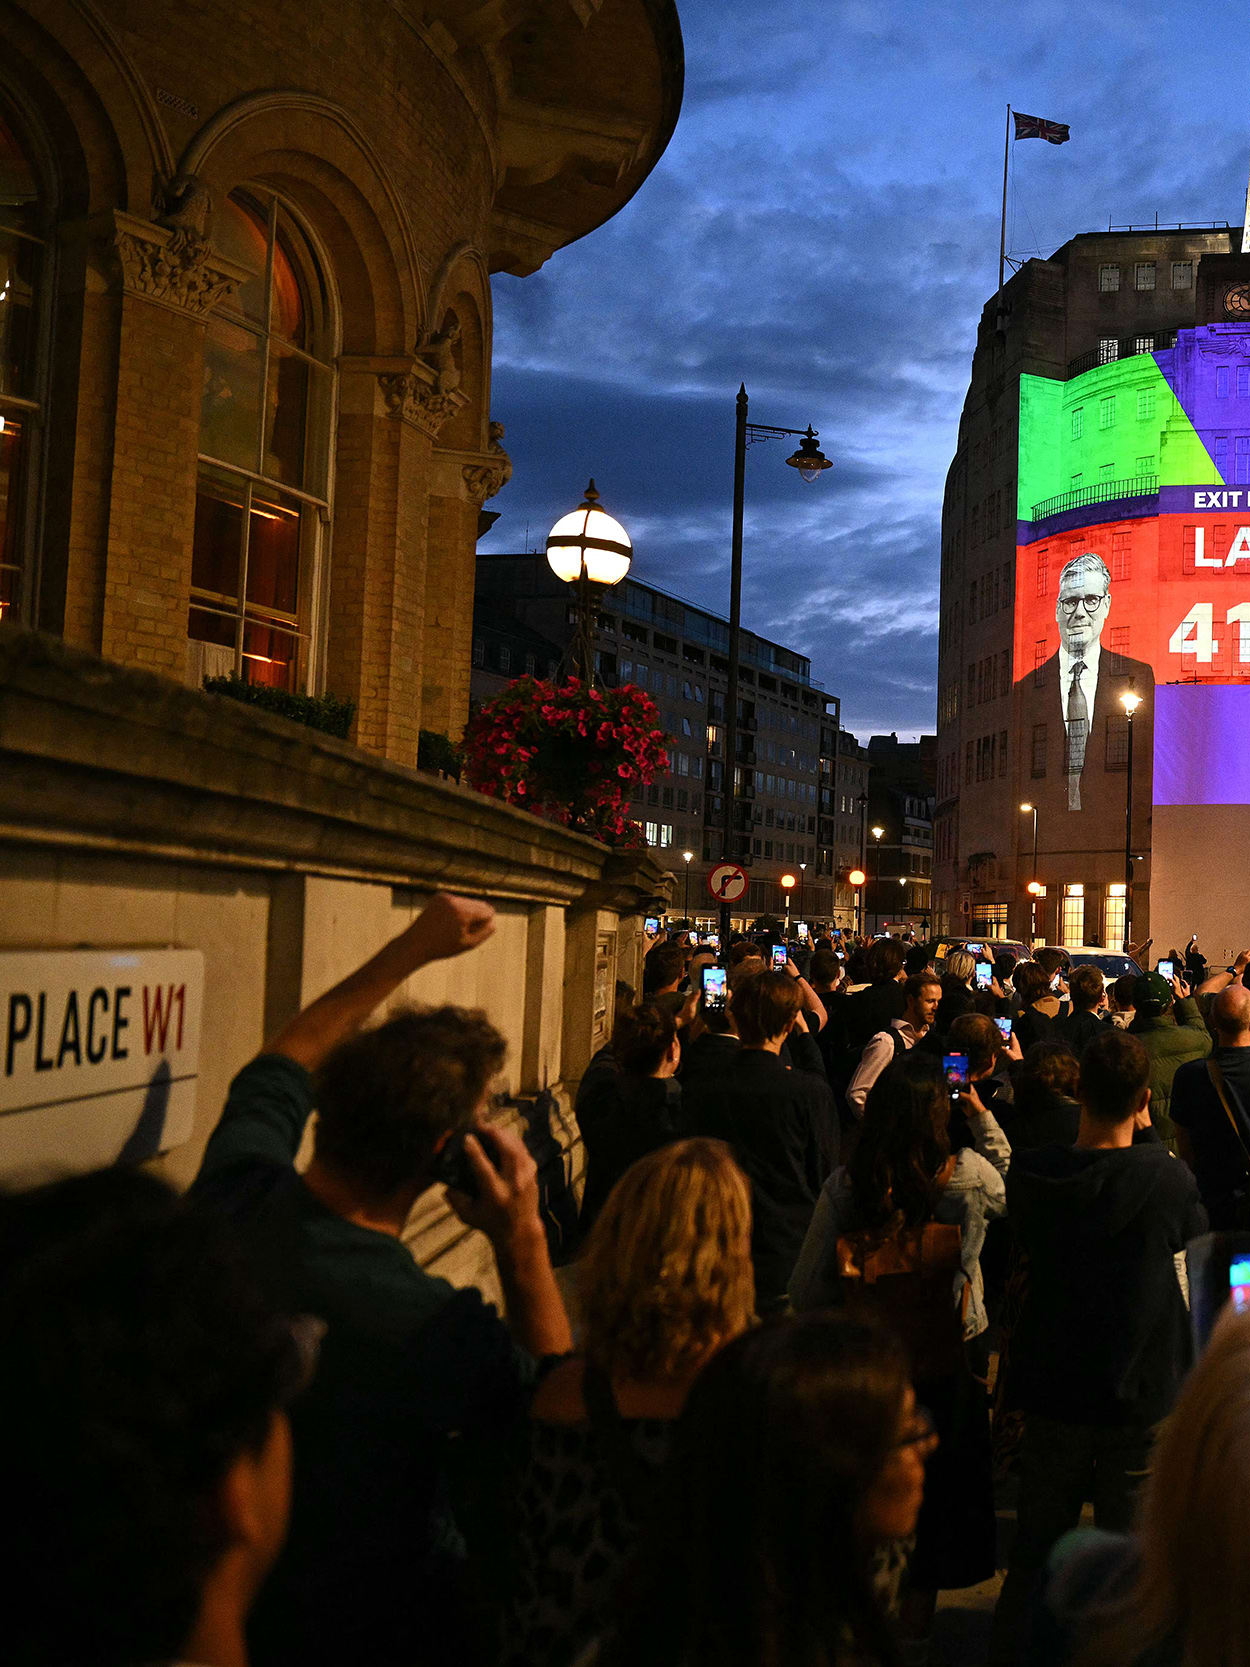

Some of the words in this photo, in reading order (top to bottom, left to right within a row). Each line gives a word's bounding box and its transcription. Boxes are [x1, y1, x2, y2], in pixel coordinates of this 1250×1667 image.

[1194, 491, 1243, 508] EXIT
[5, 986, 132, 1078] PLACE
[142, 983, 187, 1056] W1
